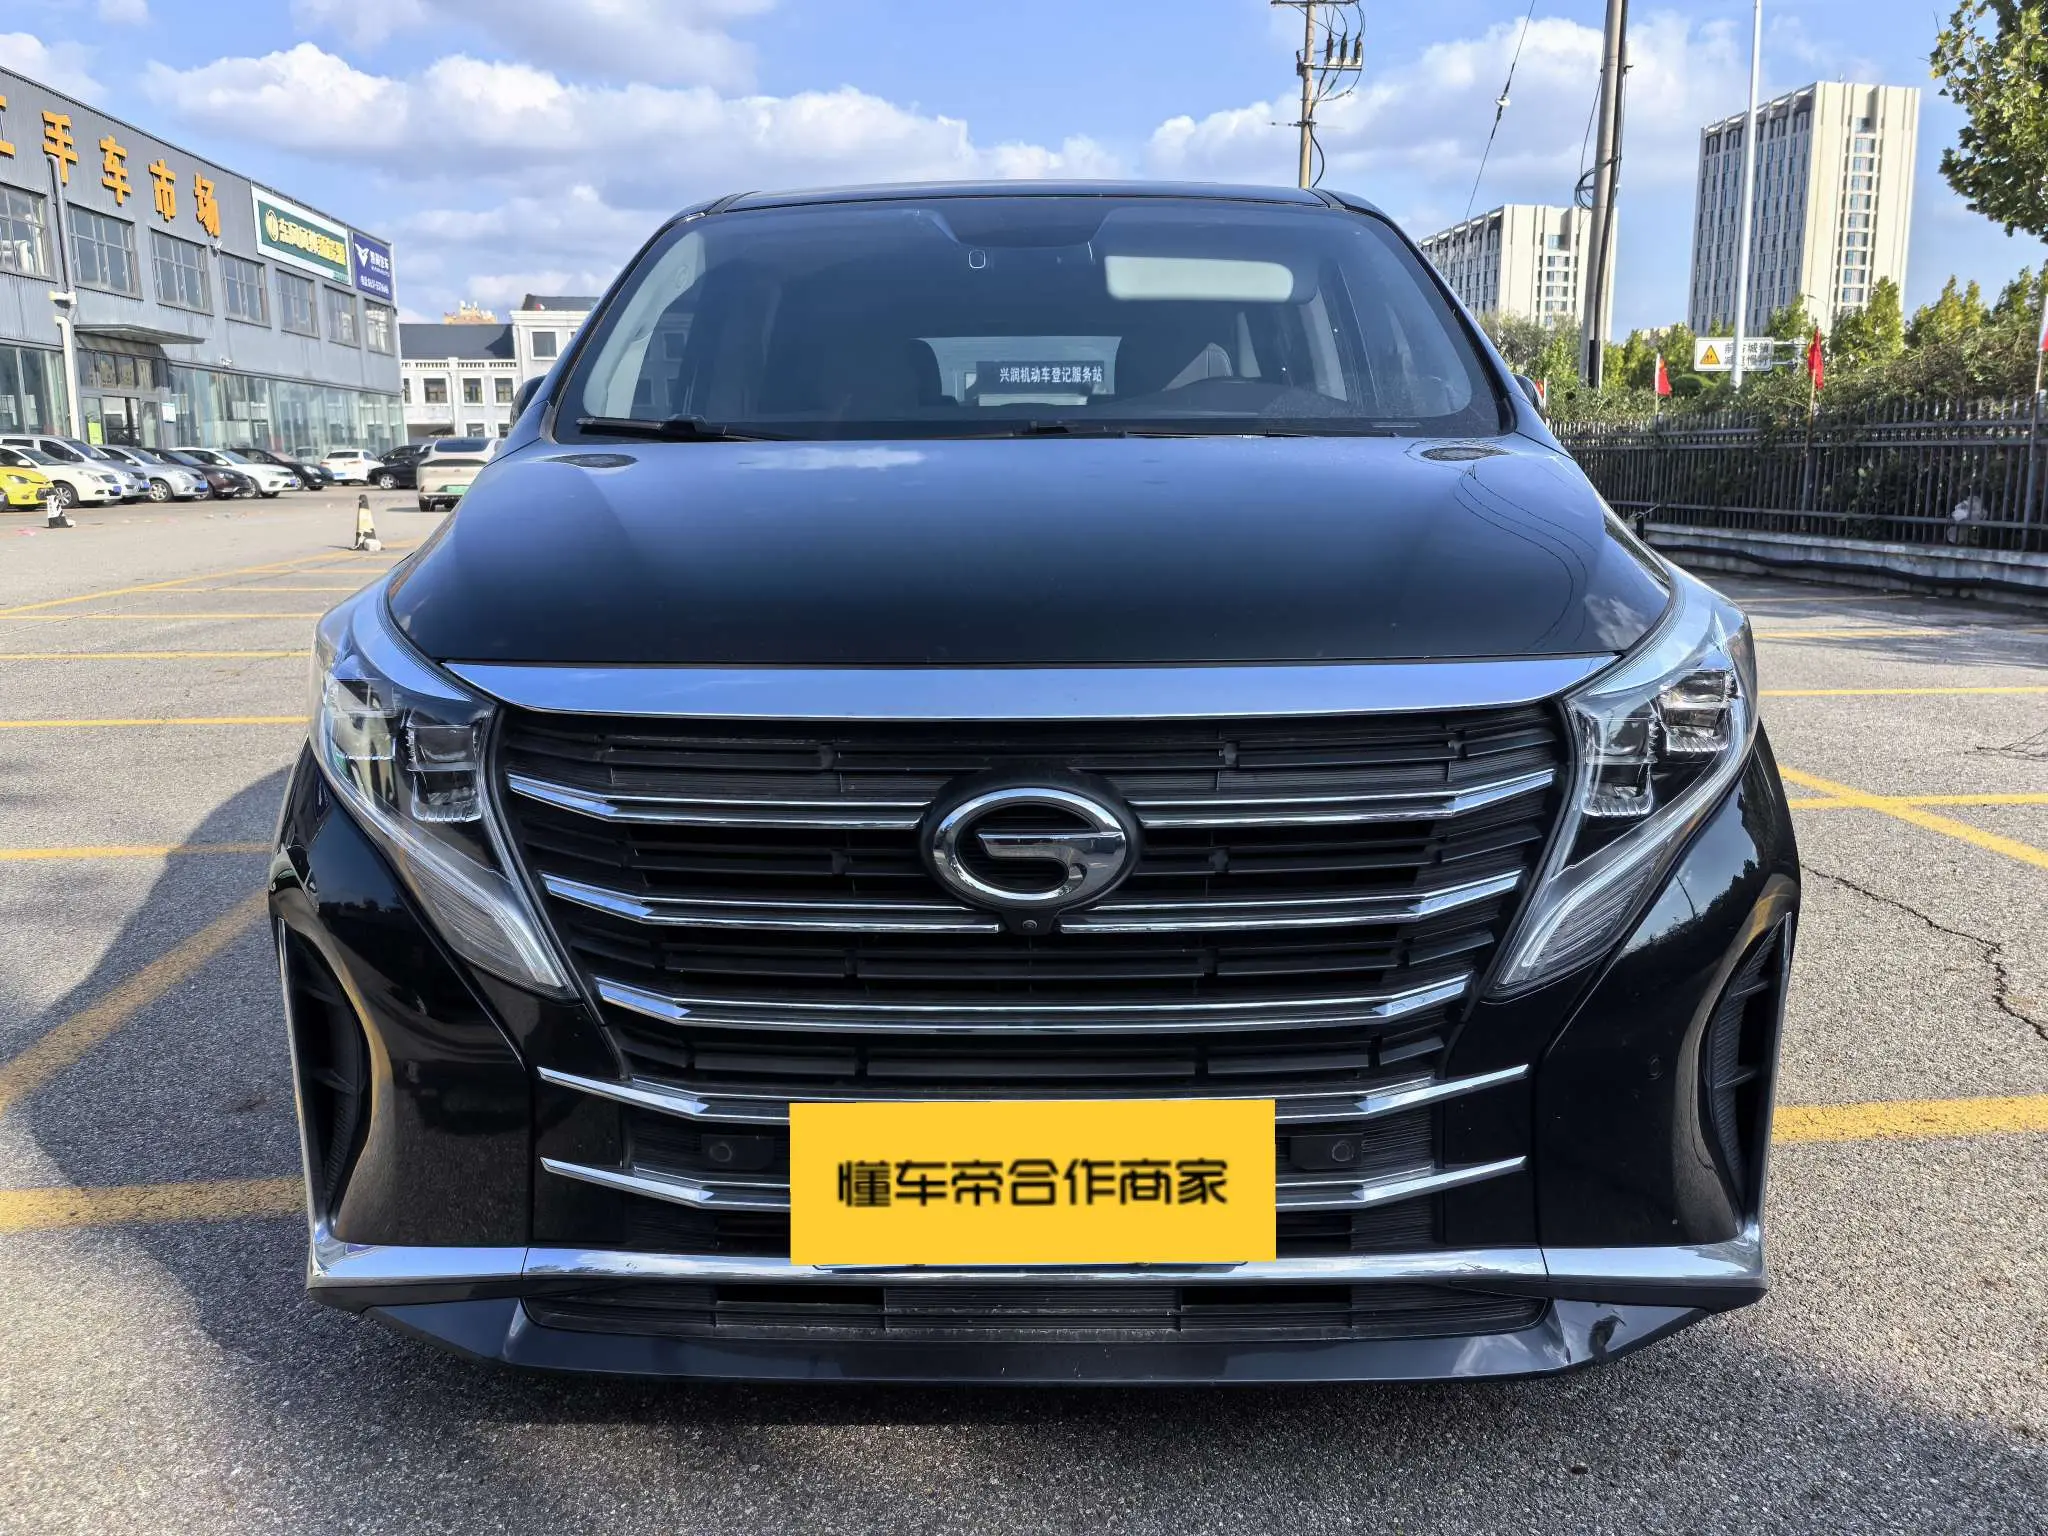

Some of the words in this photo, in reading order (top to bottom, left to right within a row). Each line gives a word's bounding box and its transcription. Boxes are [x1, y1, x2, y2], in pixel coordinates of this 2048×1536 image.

[999, 365, 1103, 384] 兴润机动车登记服务站
